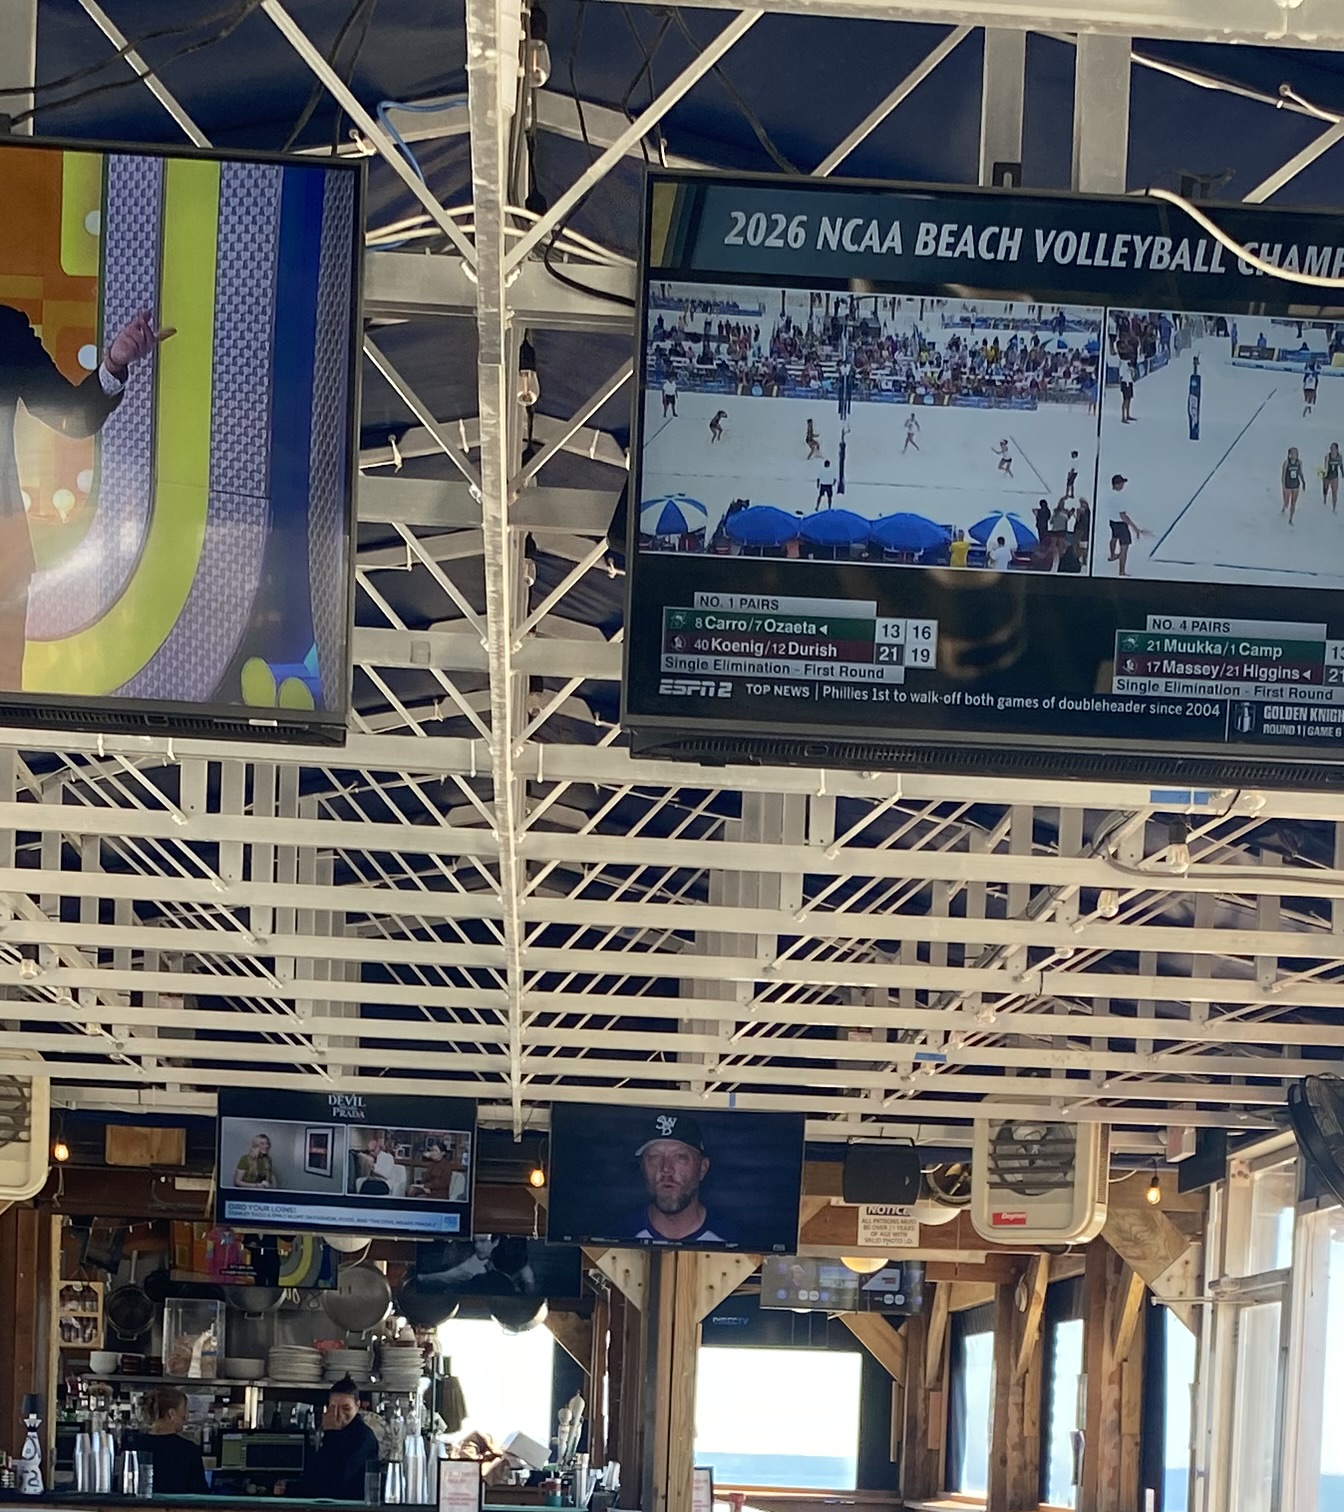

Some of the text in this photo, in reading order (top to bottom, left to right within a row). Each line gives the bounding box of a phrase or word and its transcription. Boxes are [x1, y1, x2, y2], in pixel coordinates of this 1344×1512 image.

[724, 211, 808, 249] 2026
[816, 216, 902, 255] NCAA
[914, 222, 1023, 261] BEACH
[1034, 228, 1227, 274] VOLLEYBALL
[700, 596, 780, 611] NO. 1 PAIRS
[881, 623, 901, 638] 13
[912, 625, 931, 640] 16
[1152, 619, 1231, 633] NO. 4 PAIRS
[693, 639, 710, 651] 40
[1147, 640, 1162, 652] 21
[1239, 642, 1283, 660] Camp
[879, 646, 899, 662] 21
[911, 648, 930, 663] 19
[664, 656, 709, 673] Single
[713, 657, 791, 675] Elimination
[803, 663, 837, 678] First
[839, 665, 885, 680] Round
[1146, 661, 1160, 673] 17
[746, 683, 810, 698] TOP NEWS
[1117, 678, 1160, 694] Single
[1164, 680, 1241, 697] Elimination
[1254, 685, 1285, 699] First
[1288, 687, 1333, 701] Round
[822, 685, 1221, 717] Phillies 1st to walk-off both games of doubleheader since 2004
[1264, 705, 1307, 721] GOLDEN
[1263, 724, 1295, 736] ROUND
[1307, 726, 1333, 738] GAME
[328, 1093, 366, 1107] DEVIL
[247, 1204, 270, 1212] YOUR
